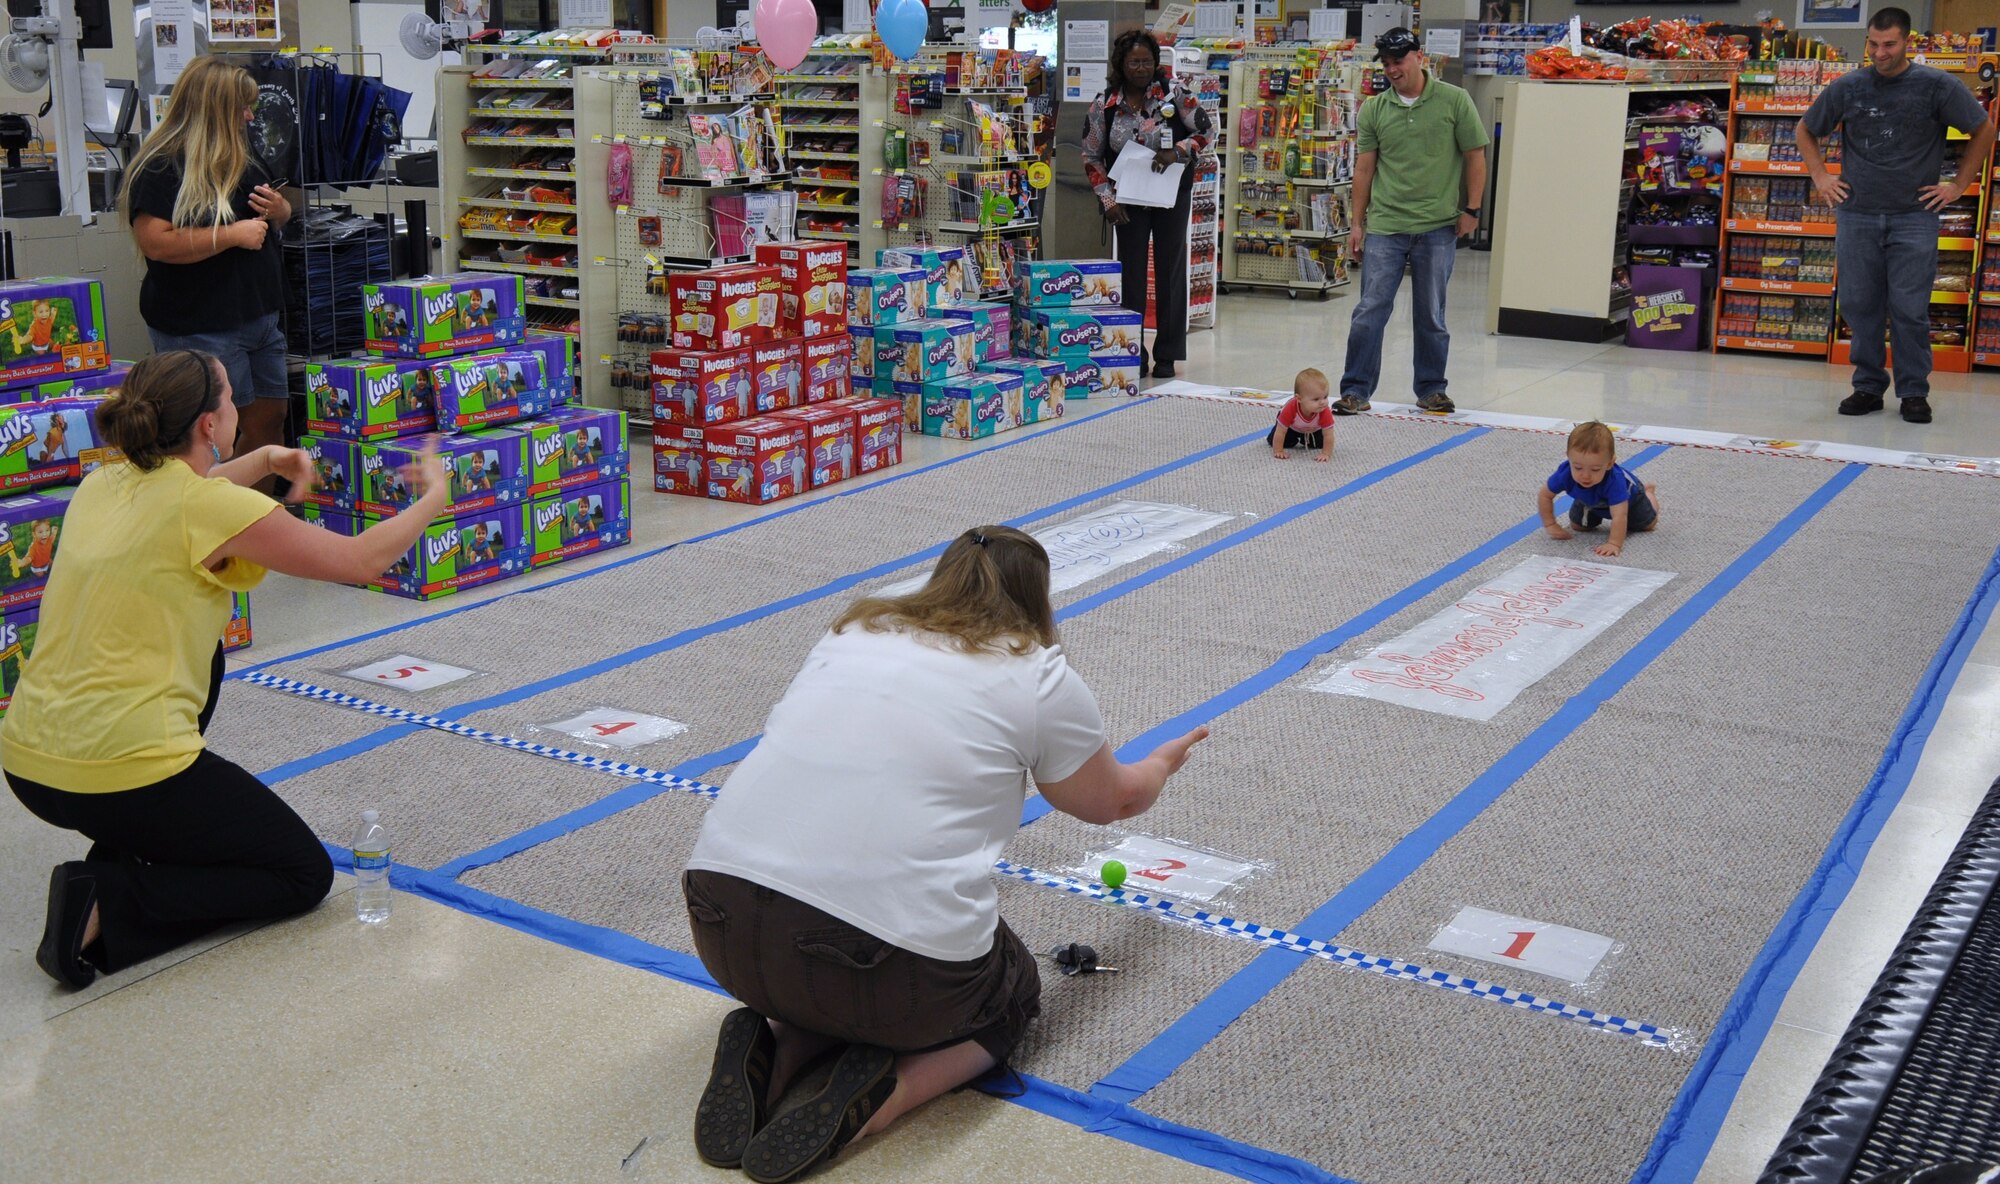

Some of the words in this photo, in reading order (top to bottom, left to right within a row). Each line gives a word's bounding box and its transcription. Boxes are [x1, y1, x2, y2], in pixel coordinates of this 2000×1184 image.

[1776, 103, 1797, 111] Peanut
[1768, 163, 1781, 171] Real
[1756, 222, 1764, 230] No
[1764, 223, 1802, 231] Preservatives
[806, 251, 842, 270] HUGGIES
[927, 267, 946, 283] Cruisers
[722, 281, 756, 297] HUGGIES
[1042, 275, 1080, 294] Cruisers
[366, 292, 384, 312] Luvs
[879, 286, 904, 308] Cruisers
[1648, 291, 1684, 306] HERSHEY'S
[424, 293, 454, 325] Luvs
[1632, 306, 1660, 328] BOO
[1662, 303, 1697, 317] CREW
[975, 326, 992, 342] Cruisers
[1060, 325, 1099, 345] Cruisers
[808, 344, 835, 357] HUGGIES
[929, 341, 953, 363] Cruisers
[1744, 339, 1757, 347] Real
[1757, 340, 1777, 349] Peanut
[1777, 341, 1794, 349] Butter
[756, 349, 785, 363] HUGGIES
[878, 348, 902, 360] Cruisers
[0, 372, 12, 380] oney
[12, 369, 26, 377] Back
[27, 365, 54, 375] Guarantee!
[652, 364, 681, 377] HUGGIES
[704, 357, 734, 373] HUGGIES
[308, 372, 328, 393] Luvs
[434, 367, 447, 388] Luvs
[455, 366, 483, 397] Luvs
[1065, 367, 1097, 386] ruisers
[368, 373, 399, 406] Luvs
[810, 386, 815, 397] 5
[1030, 383, 1048, 398] Cruisers
[1129, 386, 1135, 394] 4
[759, 395, 765, 406] 6
[978, 397, 1002, 420] Cruisers
[655, 405, 661, 414] 6
[707, 405, 713, 417] 6
[927, 404, 952, 415] Cruisers
[861, 412, 886, 426] HUGGIES
[0, 414, 32, 454] uvs
[813, 422, 840, 438] HUGGIES
[535, 433, 562, 466] Luvs
[707, 442, 737, 456] HUGGIES
[760, 435, 790, 451] HUGGIES
[363, 455, 383, 474] Luvs
[863, 455, 868, 467] 5
[13, 474, 29, 483] Money
[29, 472, 42, 480] Back
[43, 467, 69, 478] Guarantee!
[657, 475, 663, 485] 6
[815, 471, 820, 480] 6
[710, 482, 715, 492] 6
[764, 485, 769, 496] 6
[537, 502, 560, 532] Luvs
[428, 529, 458, 565] Luvs
[10, 594, 24, 602] Back
[377, 665, 429, 680] 5
[591, 720, 638, 736] 4
[1131, 857, 1187, 882] 2
[1494, 930, 1538, 961] 1
